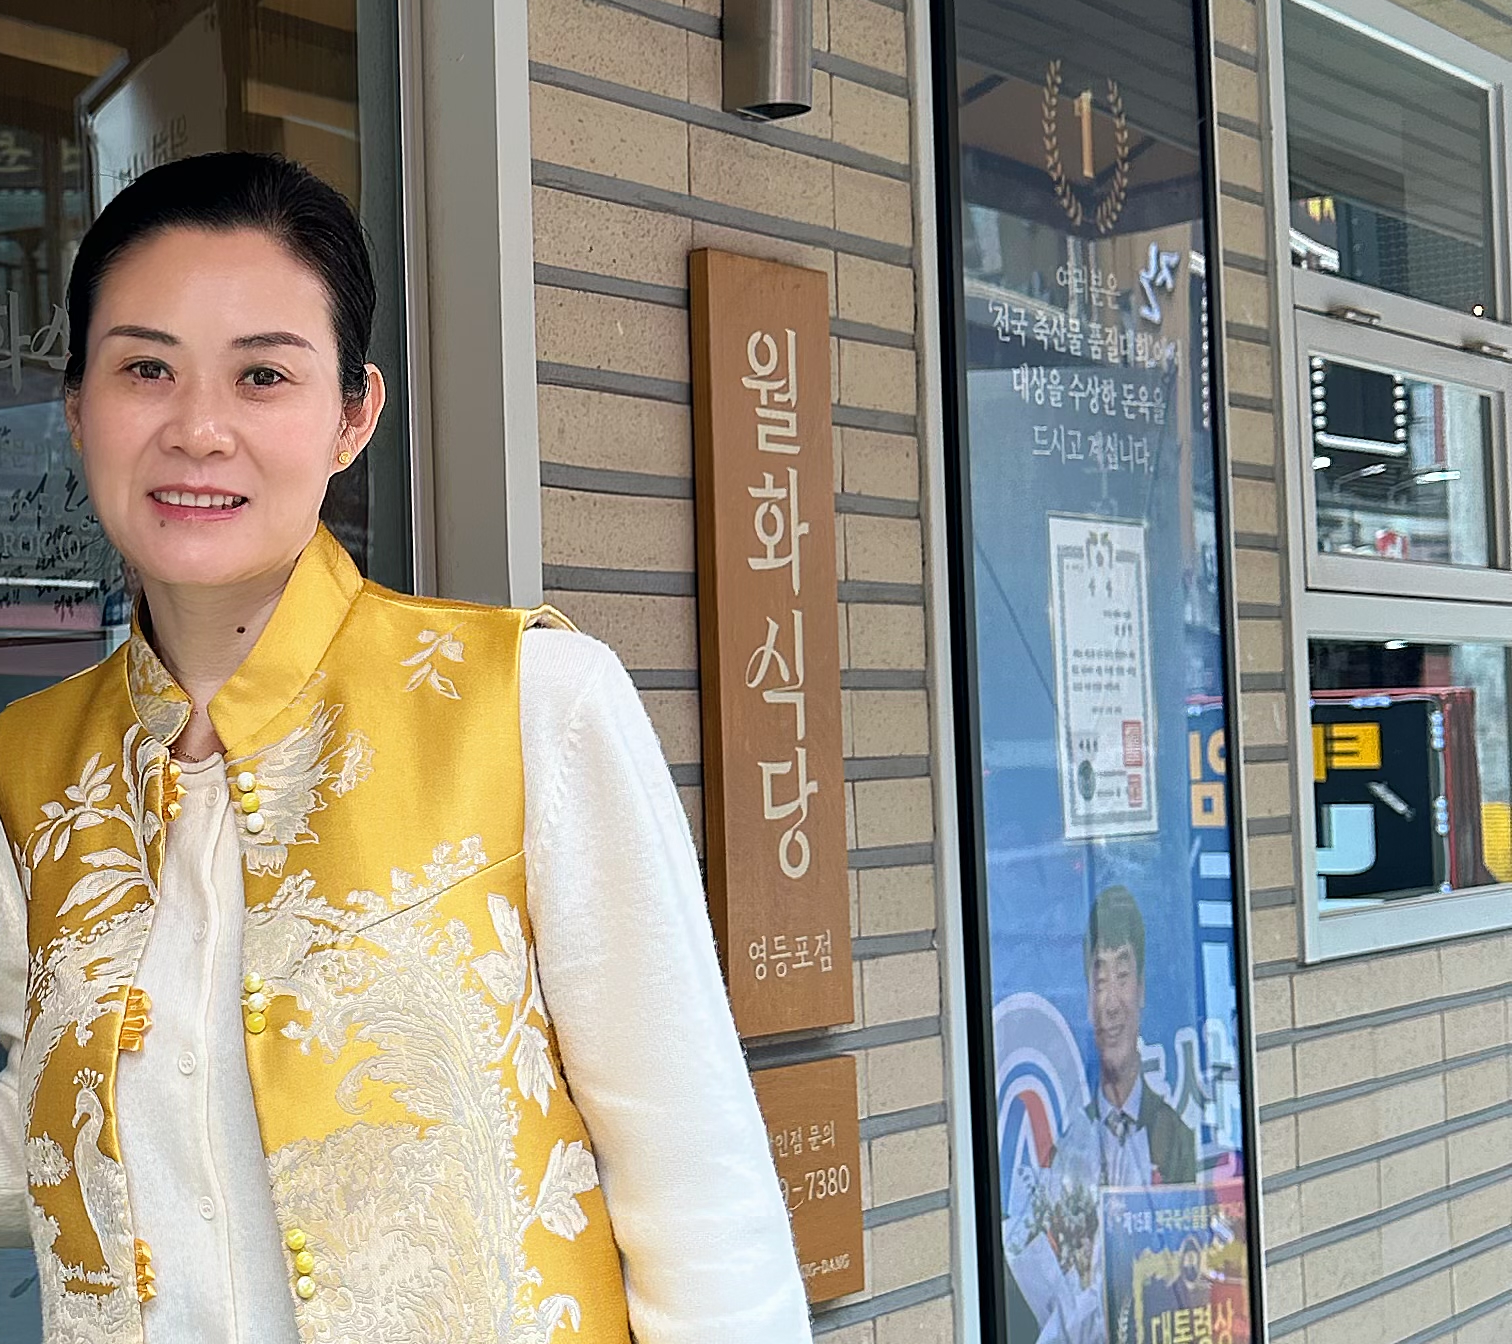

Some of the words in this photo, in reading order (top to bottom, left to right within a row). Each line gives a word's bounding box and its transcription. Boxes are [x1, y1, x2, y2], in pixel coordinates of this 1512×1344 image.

[1012, 363, 1064, 408] 대상을
[1068, 373, 1117, 416] 수상한
[1032, 424, 1084, 464] 드시고
[741, 328, 818, 880] 월화식당
[748, 929, 832, 981] 영등포점
[769, 1126, 802, 1156] 인점
[808, 1120, 835, 1151] 문의
